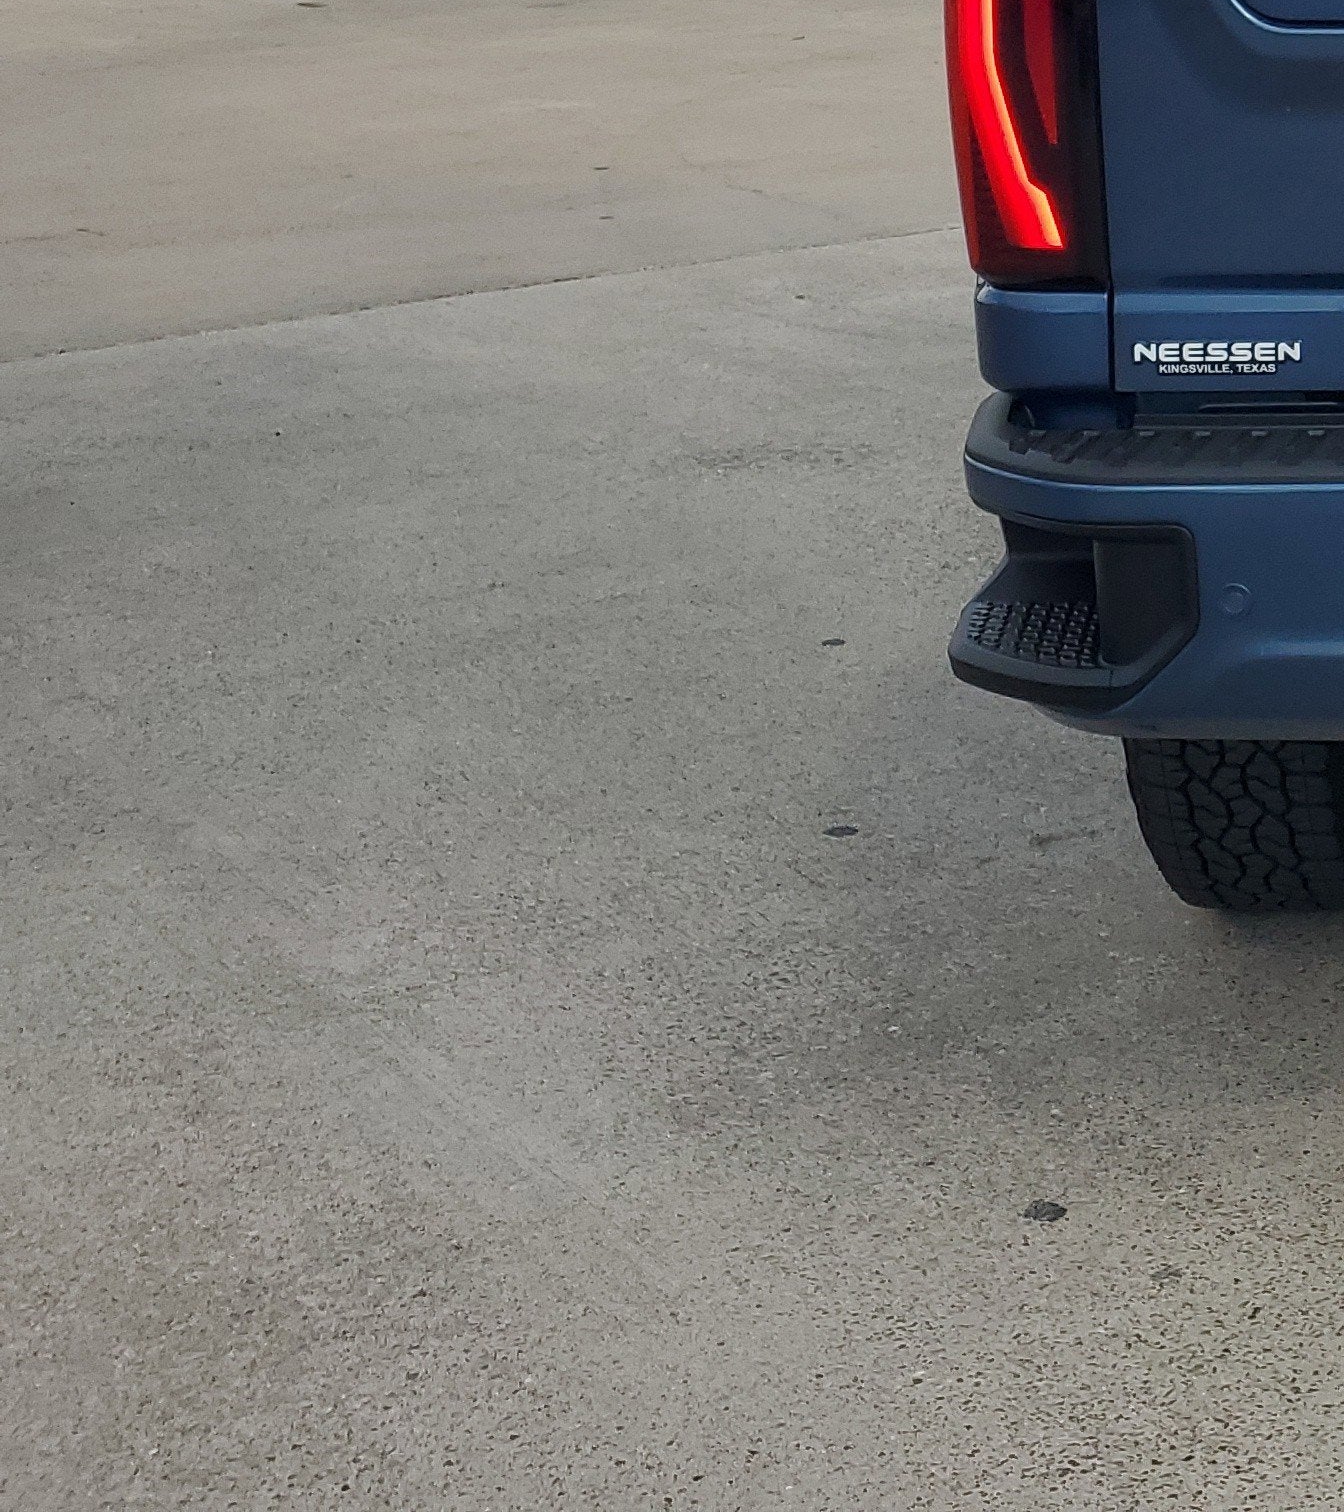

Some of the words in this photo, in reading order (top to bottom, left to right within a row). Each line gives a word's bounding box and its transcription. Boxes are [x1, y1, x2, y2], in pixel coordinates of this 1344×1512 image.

[1133, 341, 1301, 362] NEESSEN
[1158, 363, 1234, 375] KINGSVILLE,
[1235, 363, 1277, 374] TEXAS
